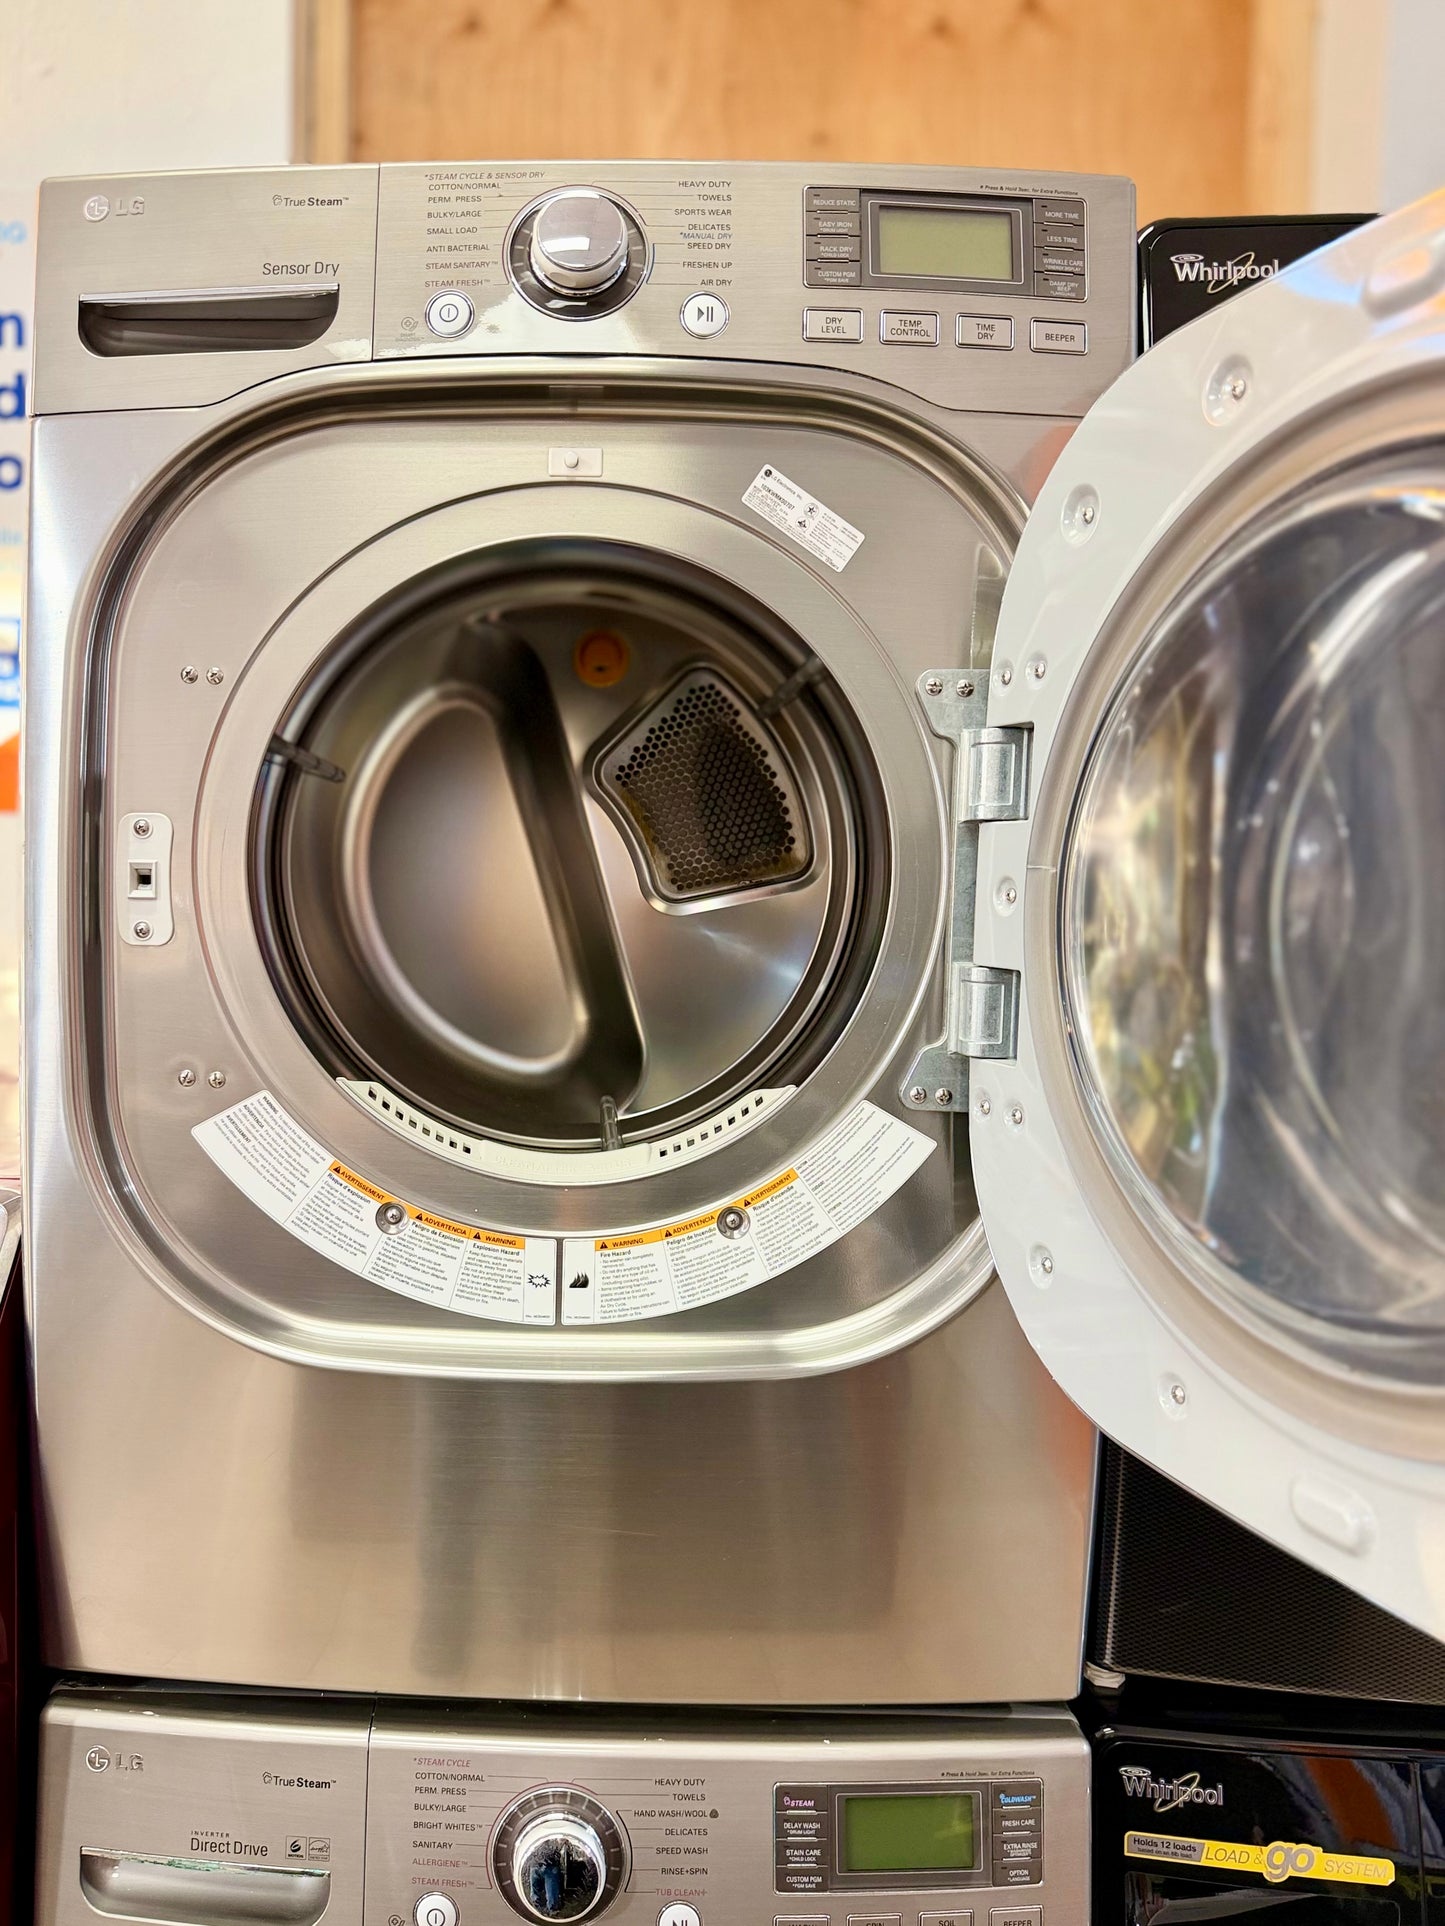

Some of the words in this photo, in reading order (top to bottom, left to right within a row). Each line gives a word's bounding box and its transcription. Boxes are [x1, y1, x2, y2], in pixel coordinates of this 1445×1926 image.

[429, 182, 501, 191] COTTON/NORMAL
[114, 195, 146, 217] LG
[427, 210, 481, 219] BULKY/LARGE
[448, 244, 490, 252] BACTERIAL
[425, 262, 451, 270] STEAM
[1043, 258, 1068, 266] WRINKLE
[262, 262, 310, 276] Sensor
[313, 261, 340, 277] Dry
[1173, 258, 1279, 286] Whirlpool
[825, 316, 843, 325] DRY
[821, 325, 846, 334] LEVEL
[976, 323, 996, 332] TIME
[890, 327, 931, 338] CONTROL
[977, 332, 994, 341] DRY
[1045, 333, 1076, 342] BEEPER
[327, 1173, 343, 1187] Risque
[341, 1171, 385, 1200] AVERTISSEMENT
[750, 1173, 792, 1202] AVERTISSEMENT
[753, 1200, 770, 1211] Risque
[412, 1221, 430, 1232] Peligro
[424, 1216, 467, 1235] ADVERTENCIA
[673, 1215, 715, 1234] ADVERTENCIA
[485, 1235, 517, 1246] WARNING
[612, 1238, 644, 1247] WARNING
[667, 1238, 685, 1246] Peligro
[473, 1243, 500, 1253] Explosion
[115, 1753, 144, 1771] LG
[447, 1759, 471, 1768] CYCLE
[415, 1772, 485, 1782] COTTON/NORMAL
[654, 1778, 681, 1786] HEAVY
[682, 1778, 706, 1787] DUTY
[441, 1787, 467, 1796] PRESS
[1122, 1775, 1224, 1807] Whirlpool
[672, 1793, 706, 1801] TOWELS
[414, 1803, 467, 1813] BULKY/LARGE
[633, 1809, 656, 1818] HAND
[658, 1809, 708, 1818] WASH/WOOL
[413, 1821, 443, 1831] BRIGHT
[191, 1830, 230, 1838] INVERTER
[665, 1827, 708, 1836] DELICATES
[190, 1837, 231, 1854] Direct
[233, 1840, 268, 1857] Drive
[412, 1840, 453, 1849] SANITARY
[1133, 1837, 1158, 1847] Holds
[1173, 1842, 1197, 1852] loads
[656, 1846, 681, 1855] SPEED
[683, 1846, 708, 1854] WASH
[1205, 1846, 1250, 1865] LOAD
[1253, 1854, 1263, 1865] &
[1266, 1844, 1316, 1880] go
[1324, 1860, 1388, 1880] SYSTEM
[661, 1867, 708, 1876] RINSE+SPIN
[411, 1877, 440, 1887] STEAM
[656, 1888, 672, 1897] TUB
